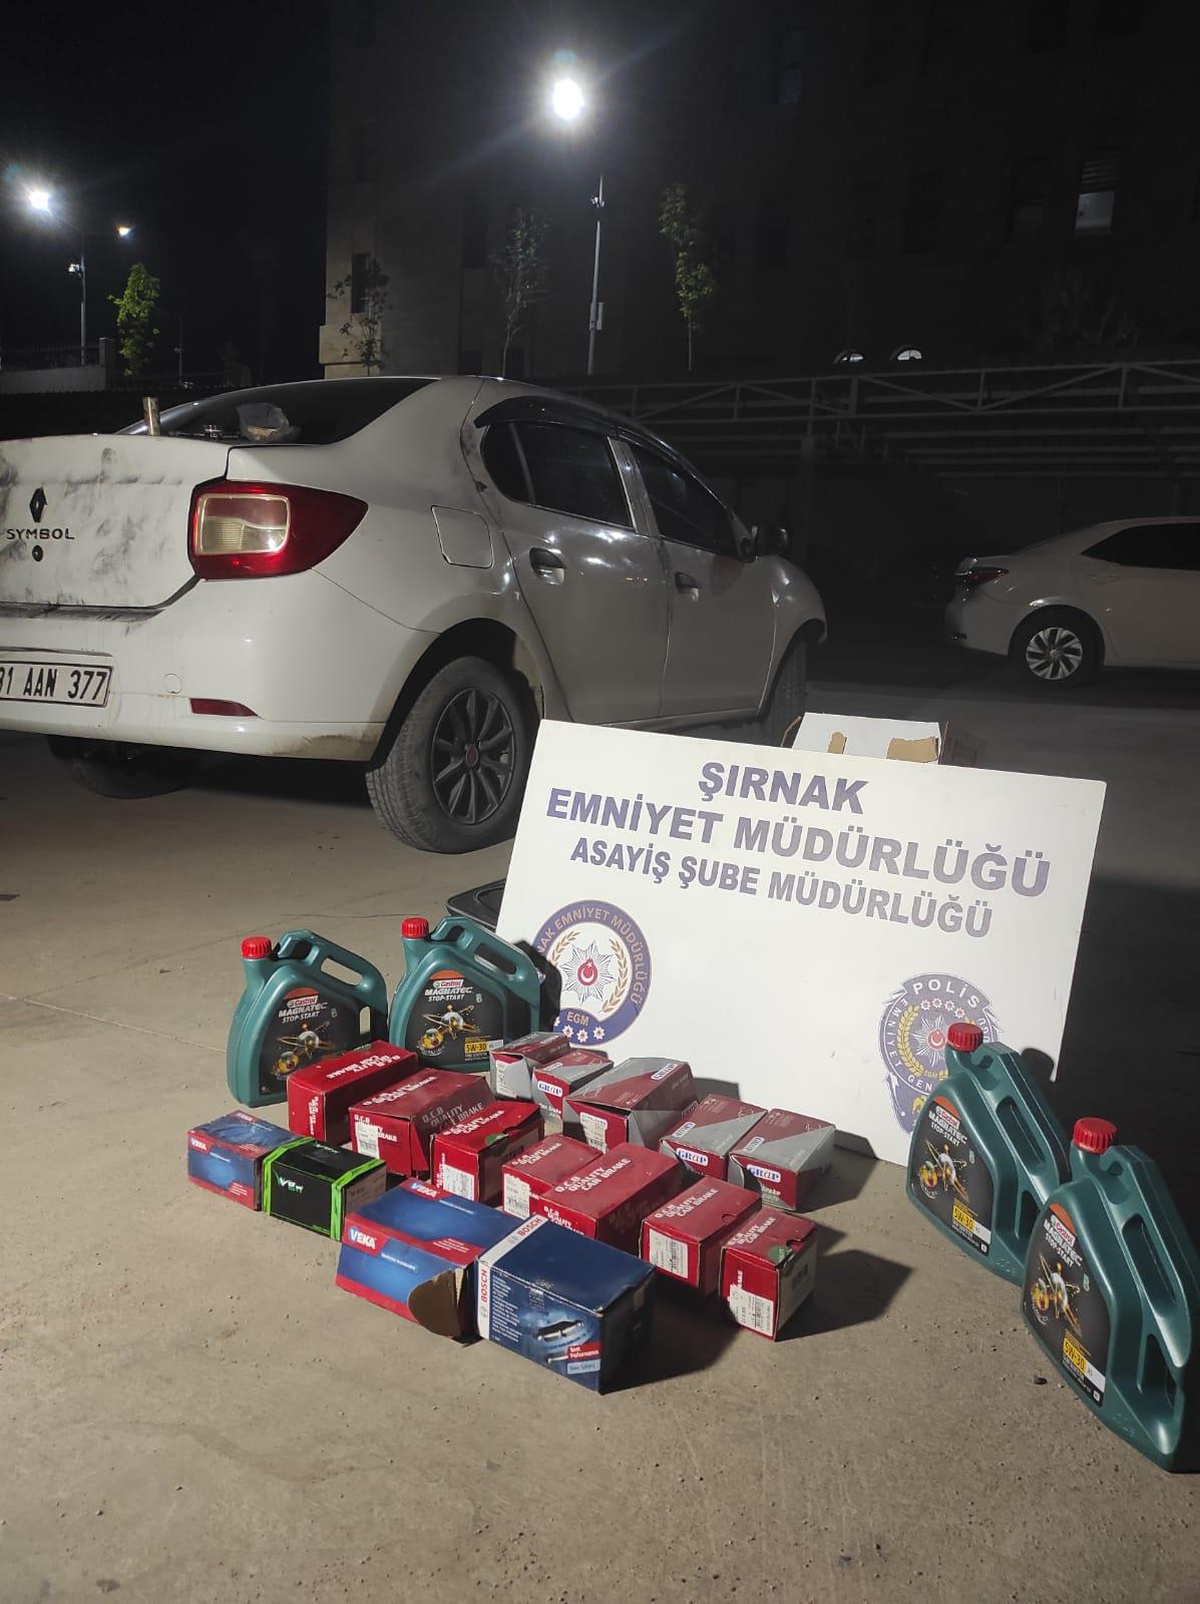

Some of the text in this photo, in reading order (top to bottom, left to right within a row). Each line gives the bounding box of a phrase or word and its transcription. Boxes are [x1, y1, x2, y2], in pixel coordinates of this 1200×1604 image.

[6, 528, 75, 541] SYMBOL
[23, 667, 57, 697] AAN
[67, 670, 108, 701] 377
[699, 762, 869, 814] ŞIRNAK
[546, 788, 1051, 898] EMNİYET MÜDÜRLÜĞÜ
[570, 837, 993, 939] ASAYİŞ ŞUBE MÜDÜRLÜĞÜ
[554, 906, 610, 930] EMNİYET
[611, 914, 648, 1005] MÜDÜRLÜĞÜ
[912, 979, 980, 1008] POLİS
[278, 1002, 328, 1018] MAGNATEC
[567, 1012, 589, 1026] EGM
[465, 1042, 487, 1052] 5W-30
[568, 1167, 605, 1191] QUALITY
[581, 1158, 631, 1191] CAR BRAKE
[350, 1228, 376, 1250] VEKA
[517, 1217, 543, 1236] BOSCH
